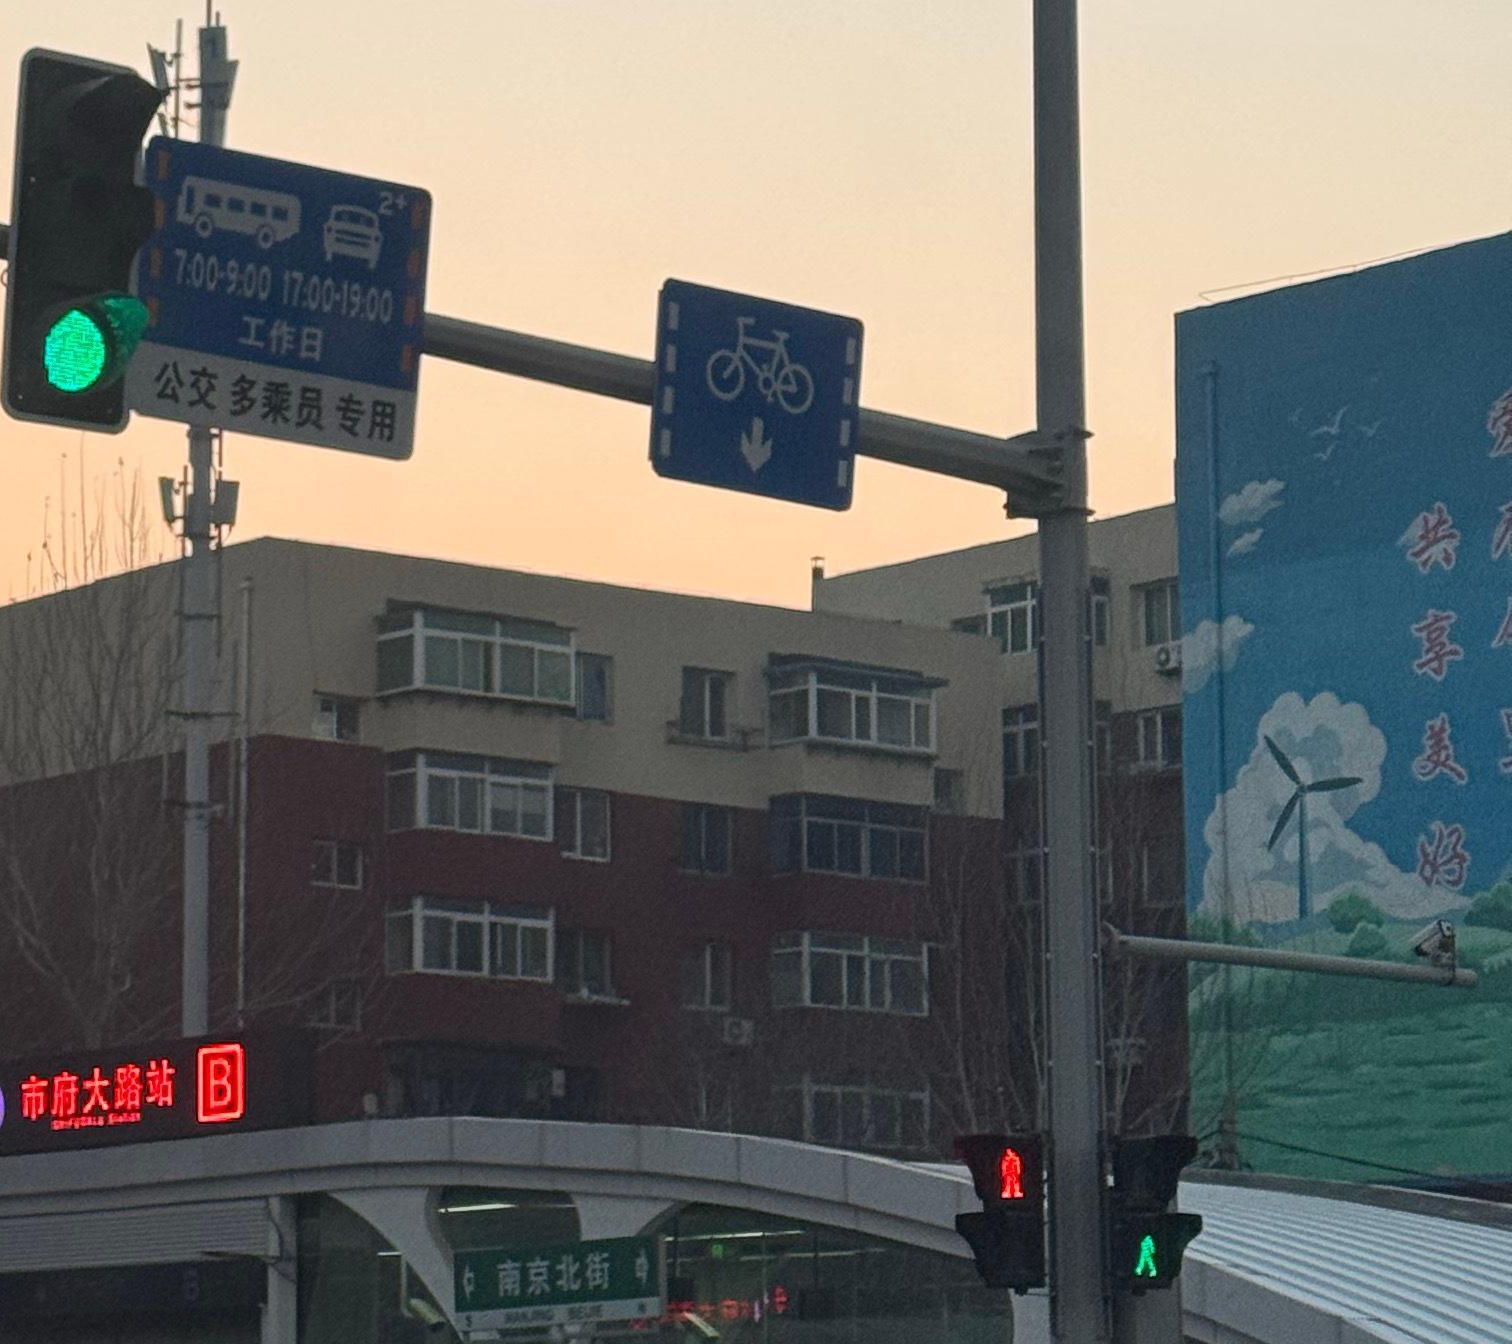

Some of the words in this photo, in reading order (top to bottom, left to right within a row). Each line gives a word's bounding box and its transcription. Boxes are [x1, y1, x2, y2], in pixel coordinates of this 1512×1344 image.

[175, 248, 272, 302] 7:00-9:00
[282, 269, 394, 325] 17:00-19:00
[239, 315, 324, 362] 工作日
[155, 360, 219, 411] 公交
[231, 373, 324, 431] 多乘员
[335, 393, 396, 442] 专用
[1406, 502, 1472, 889] 共享美好
[21, 1059, 177, 1121] 市府大路站
[209, 1057, 232, 1108] B
[496, 1251, 610, 1298] 南京北街
